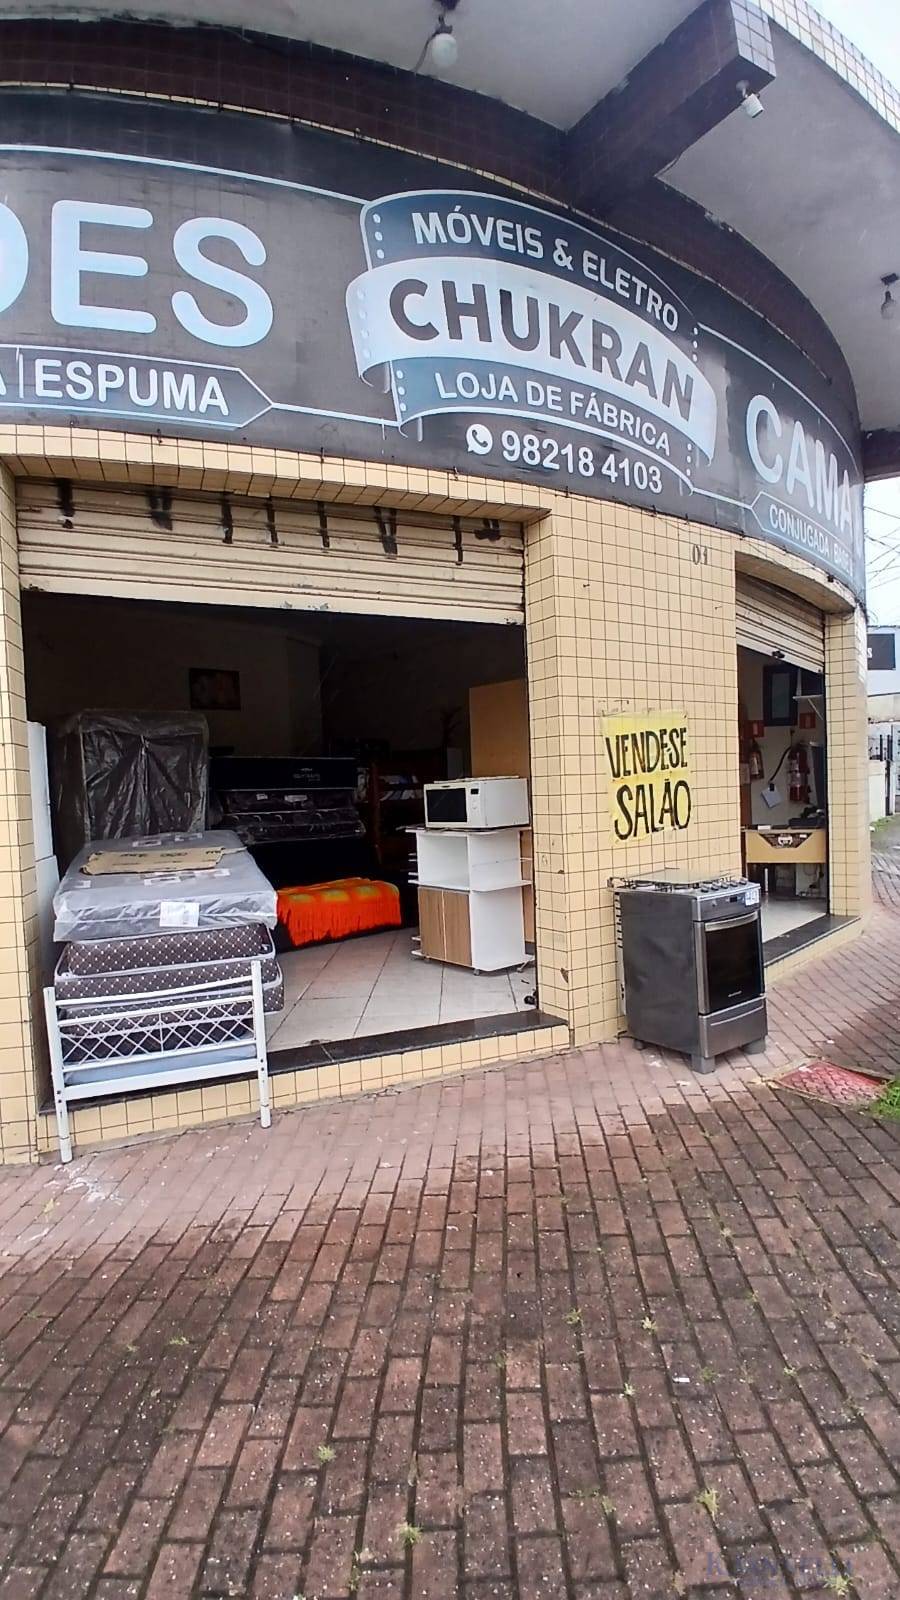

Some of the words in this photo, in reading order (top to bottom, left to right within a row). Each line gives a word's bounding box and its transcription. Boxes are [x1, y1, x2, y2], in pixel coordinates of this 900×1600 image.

[0, 200, 274, 348] ES
[411, 205, 544, 259] MÓVEIS
[553, 238, 574, 272] &
[582, 249, 679, 332] ELETRO
[35, 358, 229, 416] ESPUMA
[389, 278, 694, 422] CHUKRAN
[434, 371, 519, 403] LOJA
[526, 380, 563, 413] DE
[570, 392, 671, 456] FÁBRICA
[501, 430, 595, 478] 98218
[601, 453, 663, 494] 4103
[769, 503, 830, 558] CONJUGADA
[613, 778, 692, 841] SALÃO
